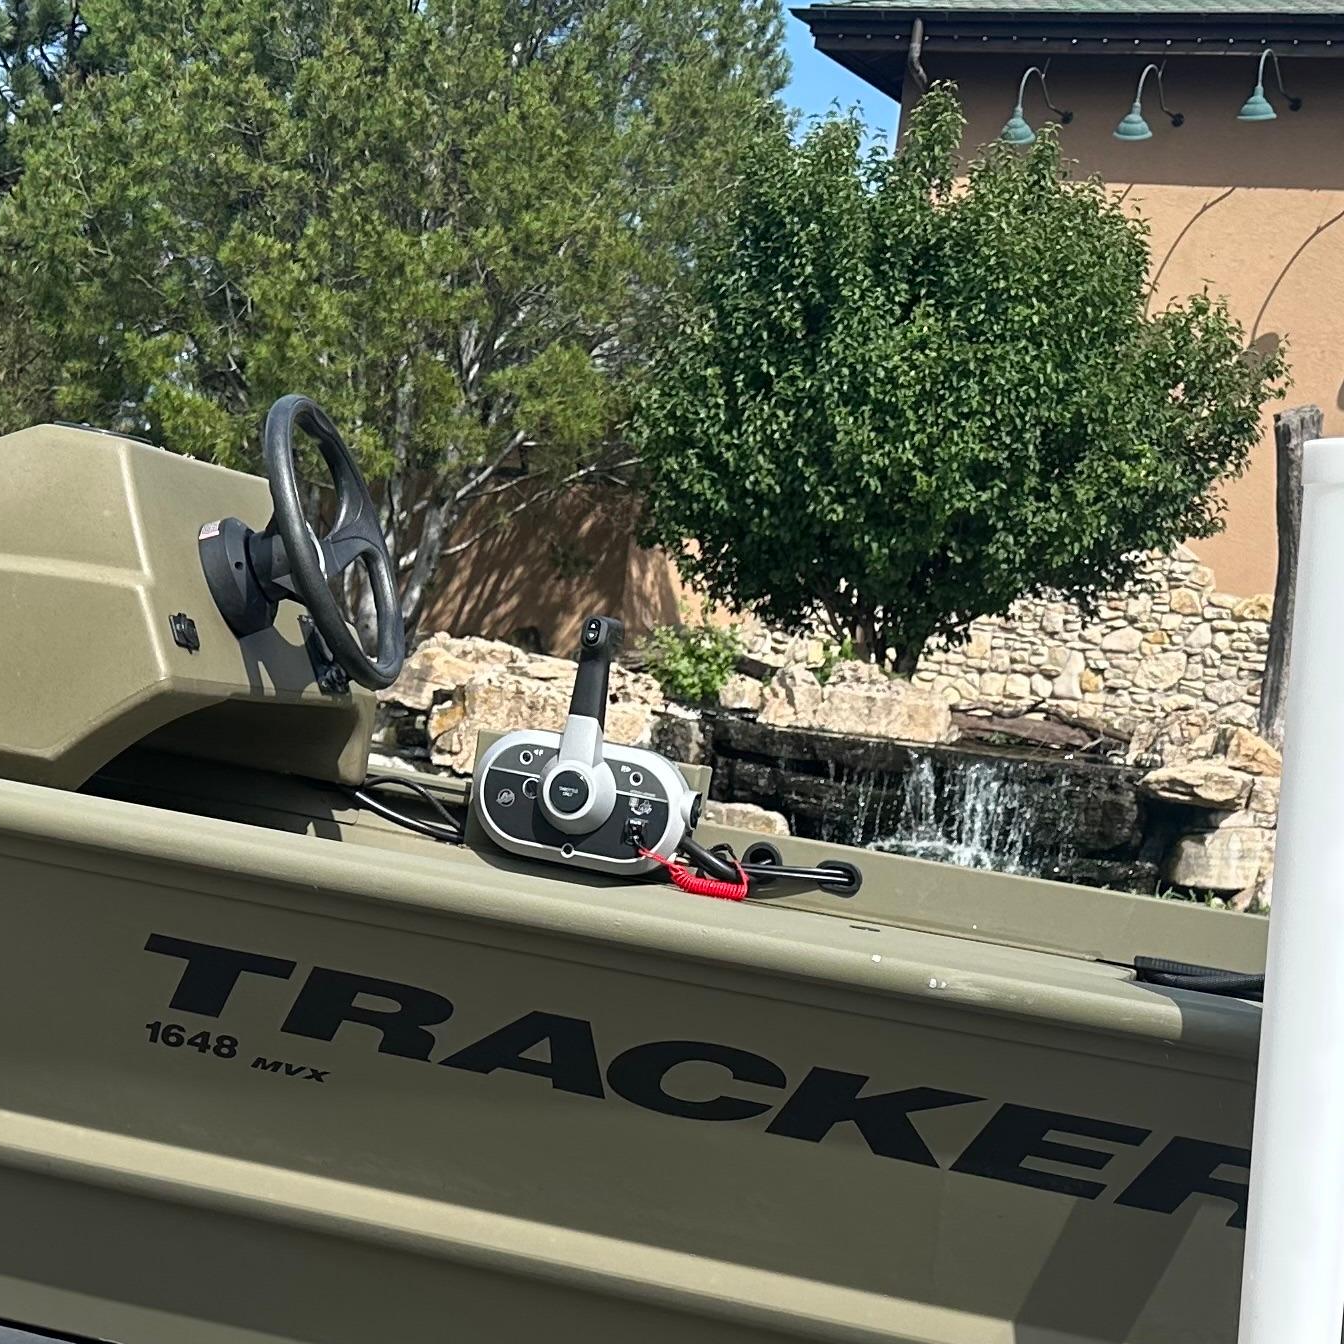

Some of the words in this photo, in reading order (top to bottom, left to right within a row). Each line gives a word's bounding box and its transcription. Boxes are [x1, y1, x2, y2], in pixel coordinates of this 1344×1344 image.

[143, 932, 1253, 1230] TRACKER
[145, 1020, 240, 1059] 1648
[250, 1056, 331, 1083] MVX
